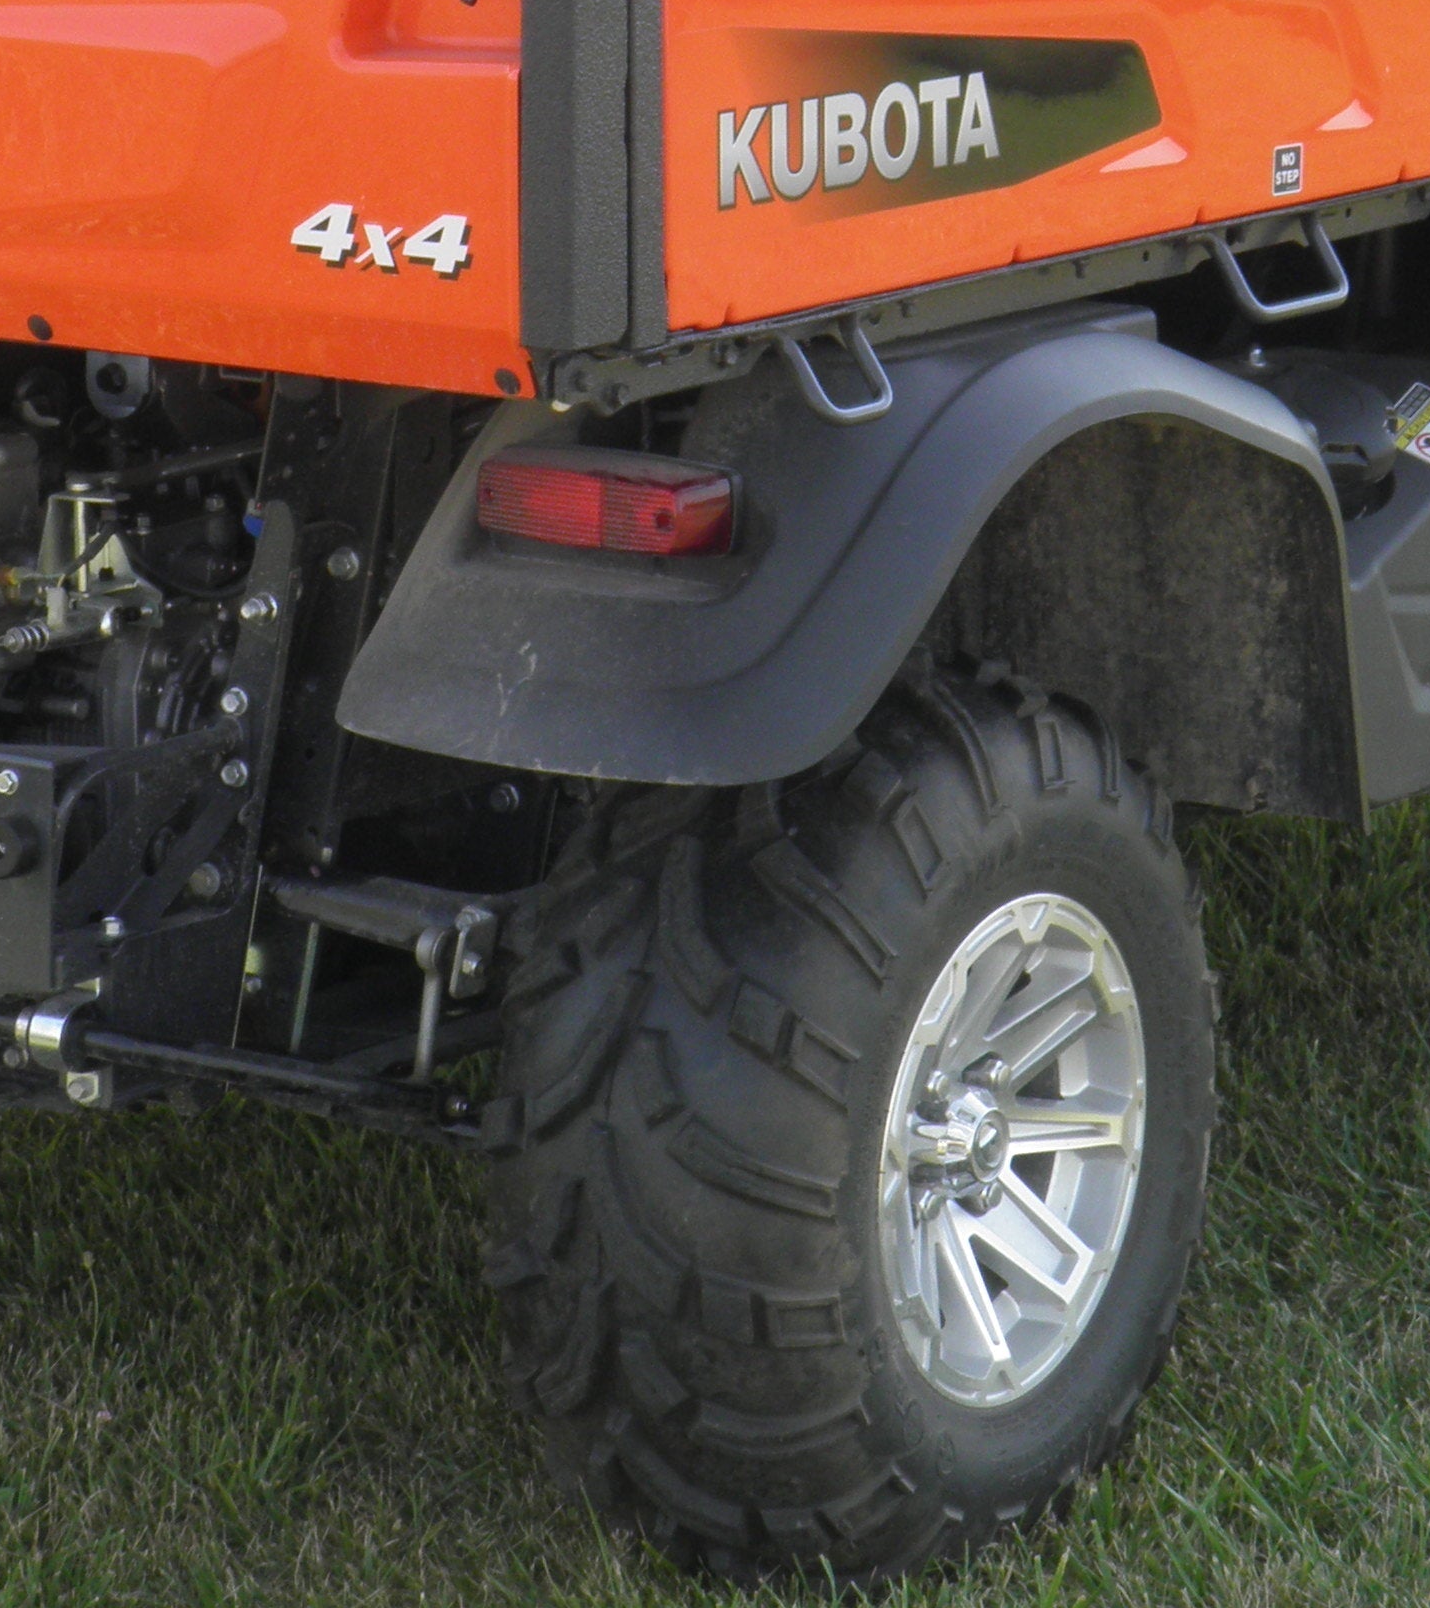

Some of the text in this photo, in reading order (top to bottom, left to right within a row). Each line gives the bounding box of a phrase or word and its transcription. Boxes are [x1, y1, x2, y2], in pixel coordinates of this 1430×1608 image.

[718, 71, 1001, 211] KUBOTA
[1280, 152, 1295, 168] NO
[1275, 169, 1300, 186] STEP
[290, 203, 472, 278] 4x4
